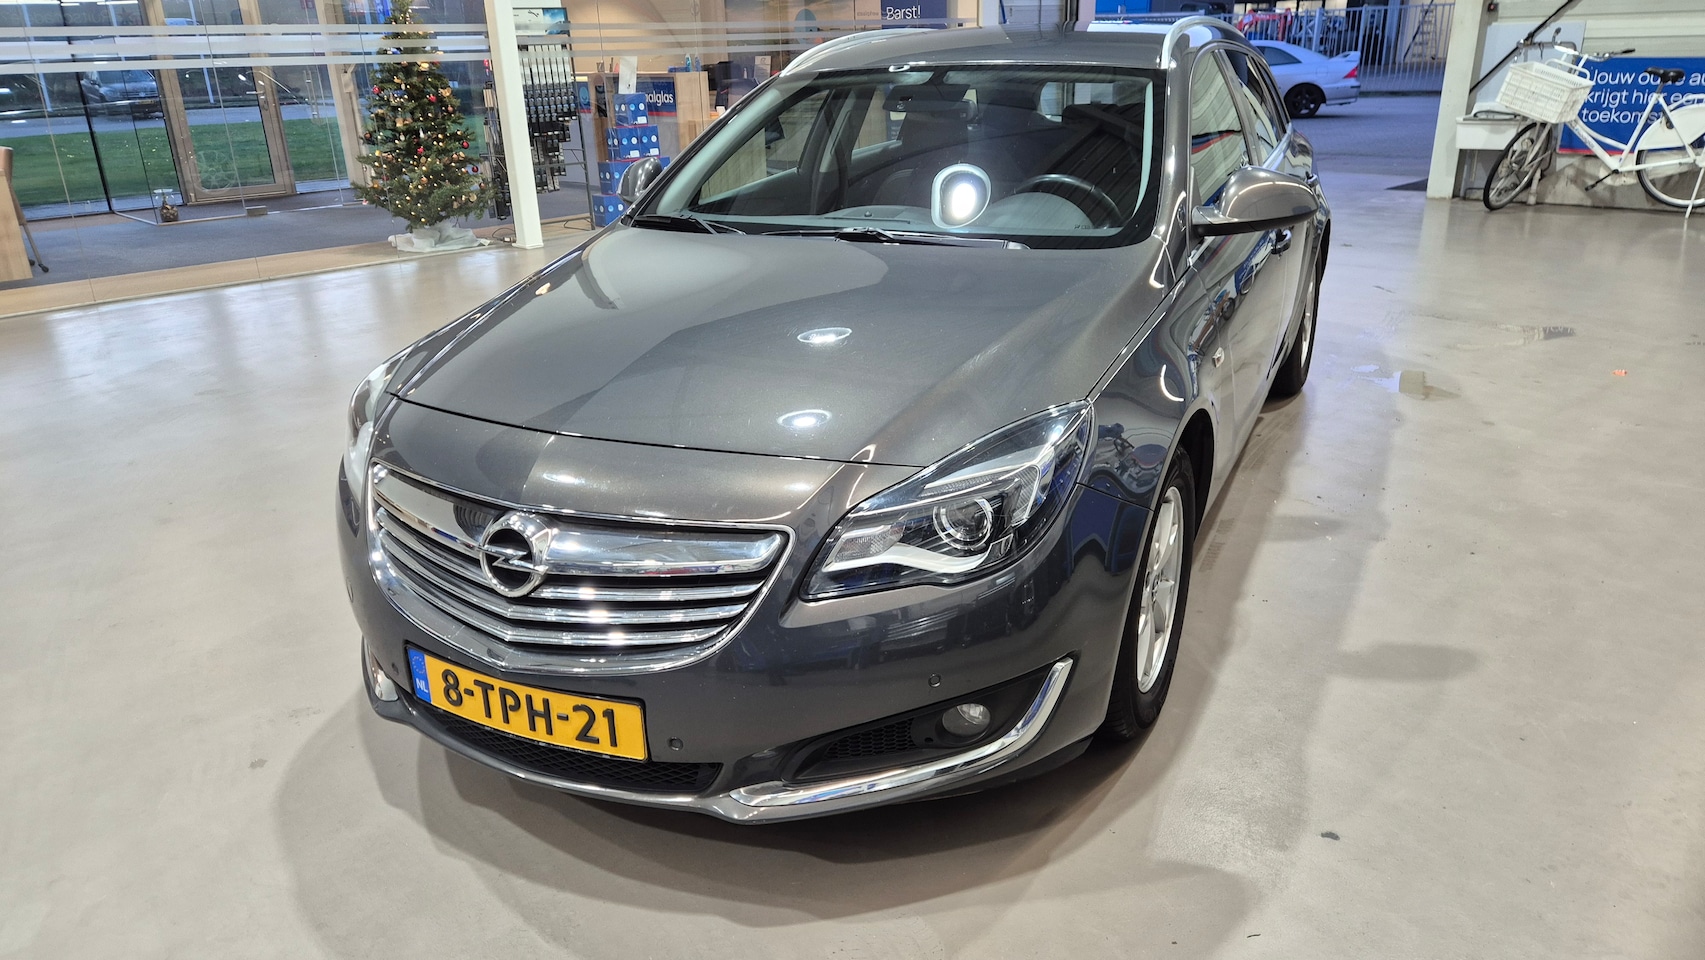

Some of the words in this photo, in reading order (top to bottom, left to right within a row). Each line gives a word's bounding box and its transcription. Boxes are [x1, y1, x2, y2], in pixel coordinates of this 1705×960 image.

[886, 5, 921, 20] Barst!
[1591, 69, 1635, 85] Jouw
[1638, 72, 1686, 86] oue
[1585, 88, 1629, 108] krijgt
[416, 678, 429, 693] NL
[441, 668, 618, 748] 8-TPH-21
